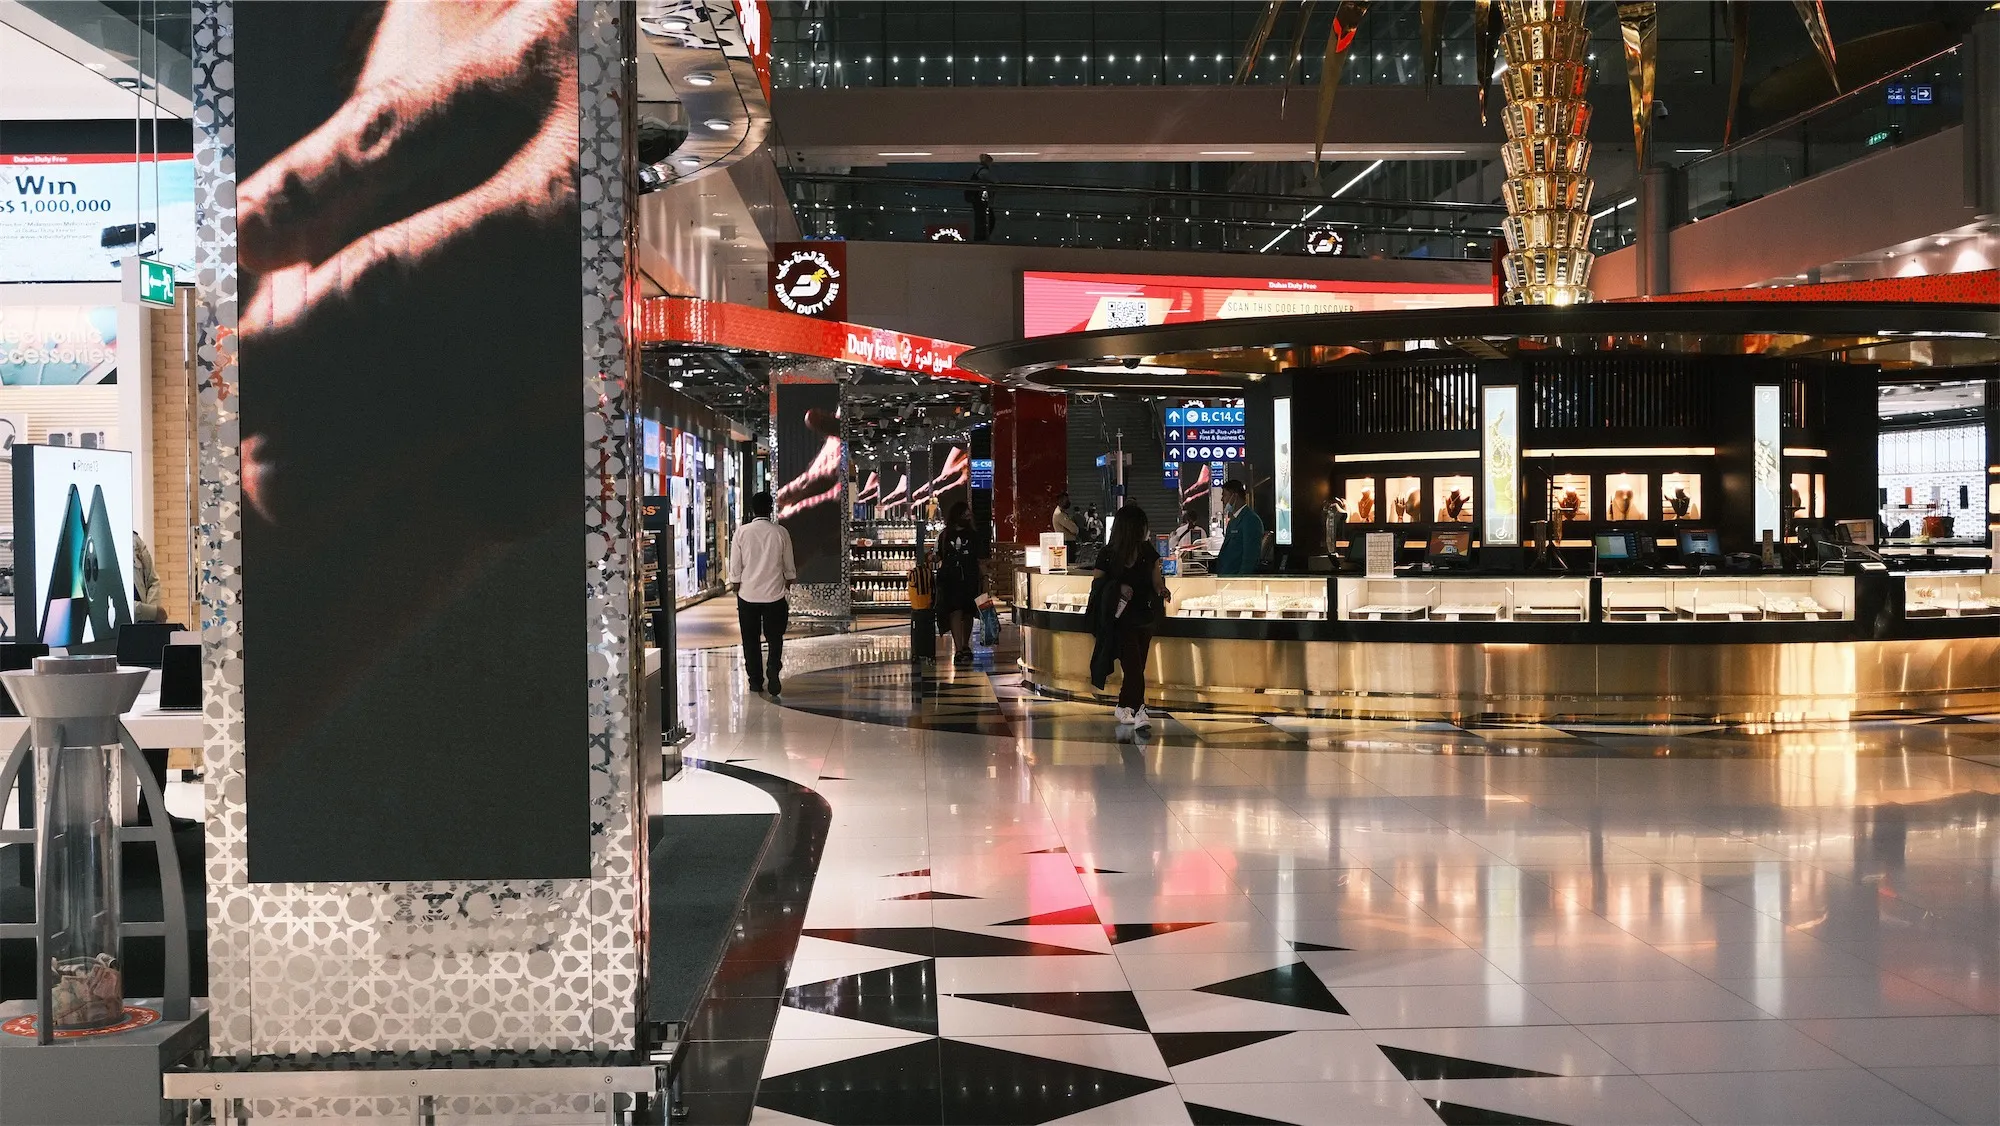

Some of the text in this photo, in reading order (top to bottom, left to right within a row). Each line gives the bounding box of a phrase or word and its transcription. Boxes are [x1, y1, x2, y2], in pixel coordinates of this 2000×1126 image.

[35, 156, 51, 164] Duty
[15, 175, 76, 195] Win
[21, 199, 111, 214] 1,000,000
[774, 282, 840, 315] DUBAI DUTY FREE
[1227, 302, 1249, 312] SCAN
[1253, 302, 1272, 313] THIS
[1275, 303, 1297, 313] CODE
[1300, 303, 1310, 314] TO
[847, 333, 874, 361] Duty
[875, 338, 897, 361] Free
[1201, 411, 1211, 423] B,
[1212, 411, 1234, 422] C14,
